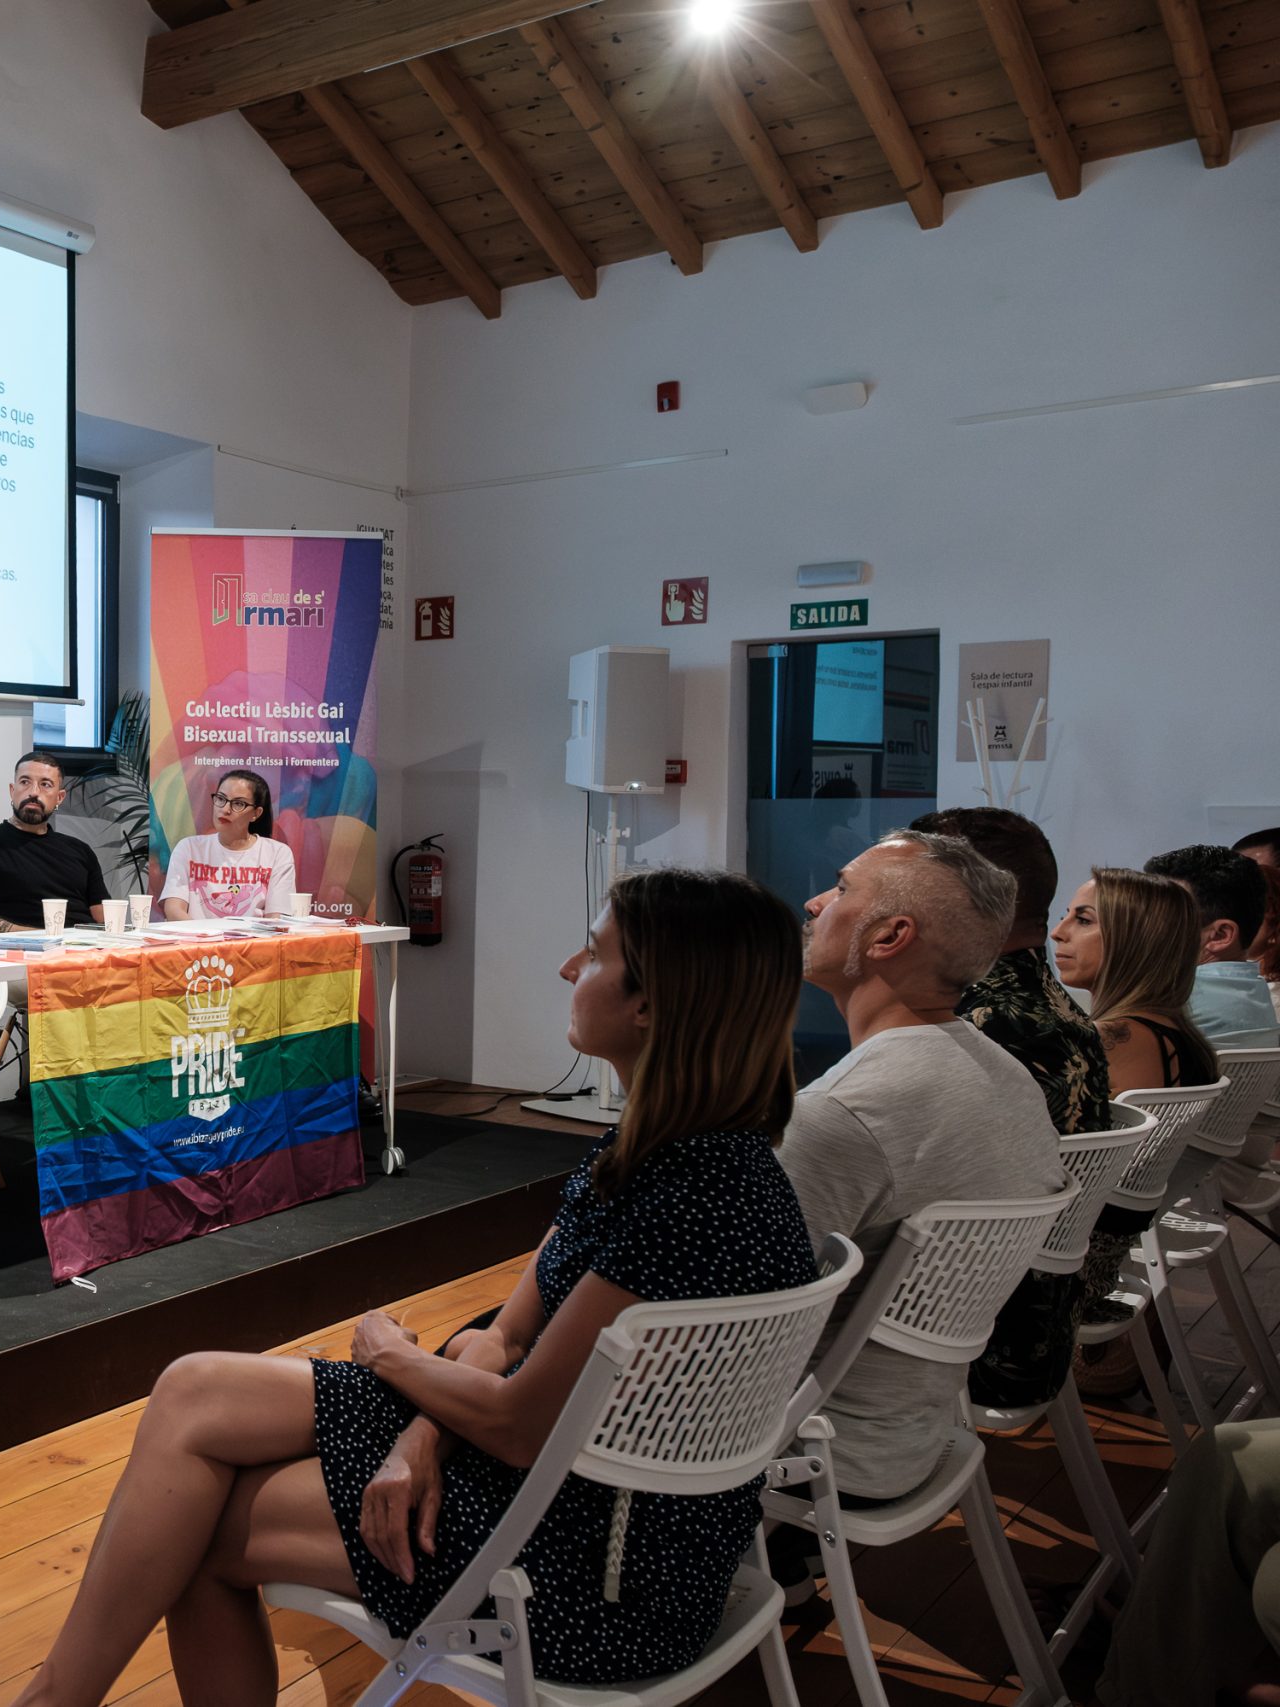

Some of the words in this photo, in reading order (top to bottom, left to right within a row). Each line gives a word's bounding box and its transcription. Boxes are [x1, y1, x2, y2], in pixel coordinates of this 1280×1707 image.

[10, 408, 34, 425] que
[243, 592, 258, 604] sa
[262, 588, 290, 604] clau
[293, 589, 312, 604] de
[314, 590, 325, 604] s'
[244, 606, 325, 627] rmari
[797, 605, 860, 625] SALIDA
[970, 672, 988, 680] Sala
[990, 672, 1000, 680] de
[976, 680, 1000, 689] espai
[1001, 680, 1032, 688] infantil
[265, 701, 314, 719] Lèsbic
[317, 702, 344, 719] Gai
[184, 726, 252, 744] Bisexual
[256, 726, 350, 744] Transsexual
[194, 756, 244, 768] Intergènere
[285, 757, 289, 767] i
[290, 756, 340, 768] Formentera
[190, 860, 219, 884] PINK
[171, 1028, 245, 1098] PRIDE
